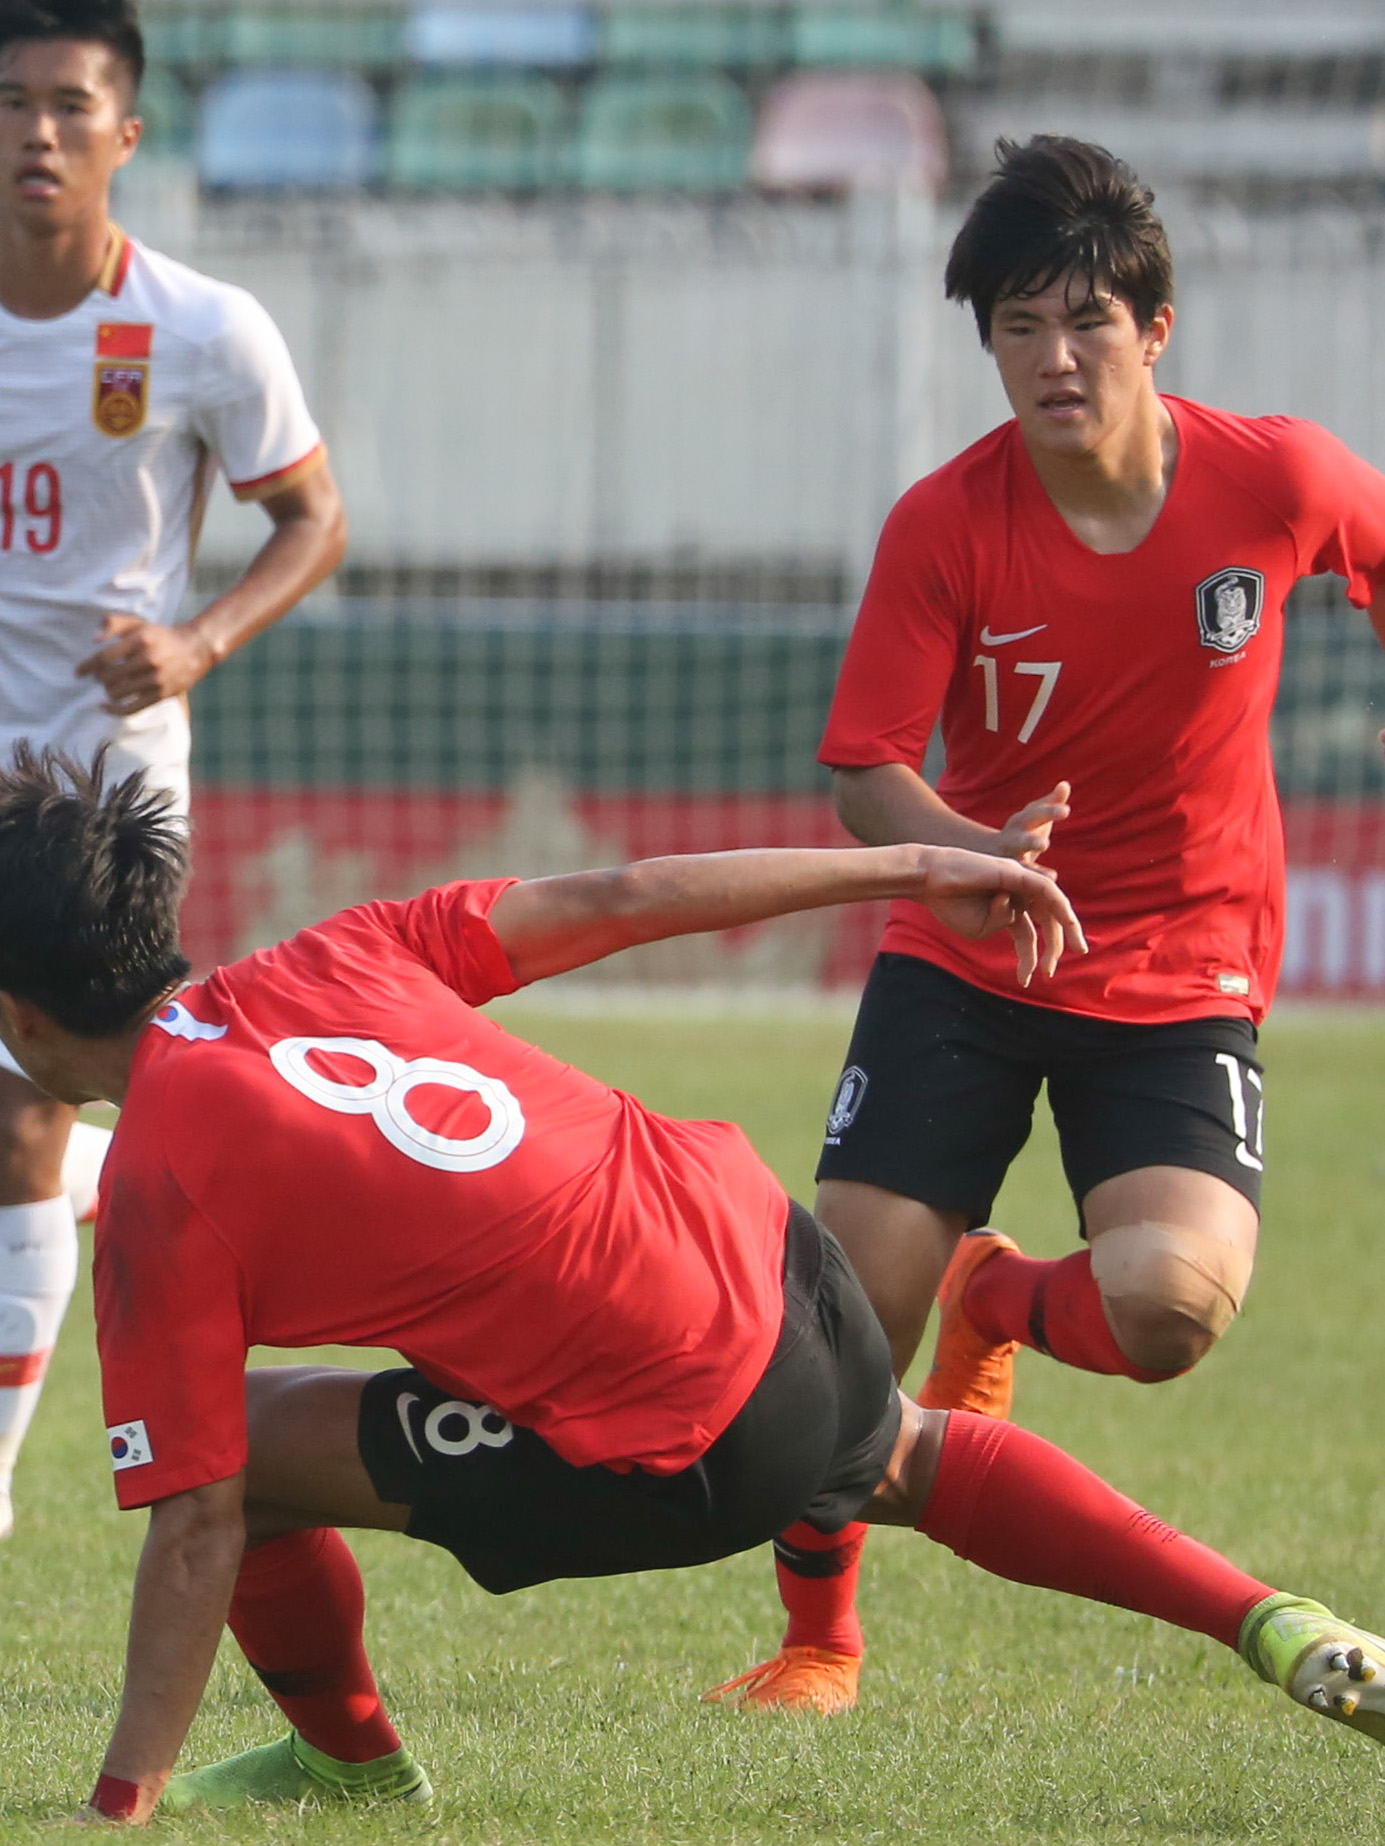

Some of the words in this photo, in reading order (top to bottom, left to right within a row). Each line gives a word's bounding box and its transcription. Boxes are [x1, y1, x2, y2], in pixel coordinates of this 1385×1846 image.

[973, 655, 1063, 744] 17
[269, 1036, 526, 1173] 8
[424, 1400, 514, 1456] 8
